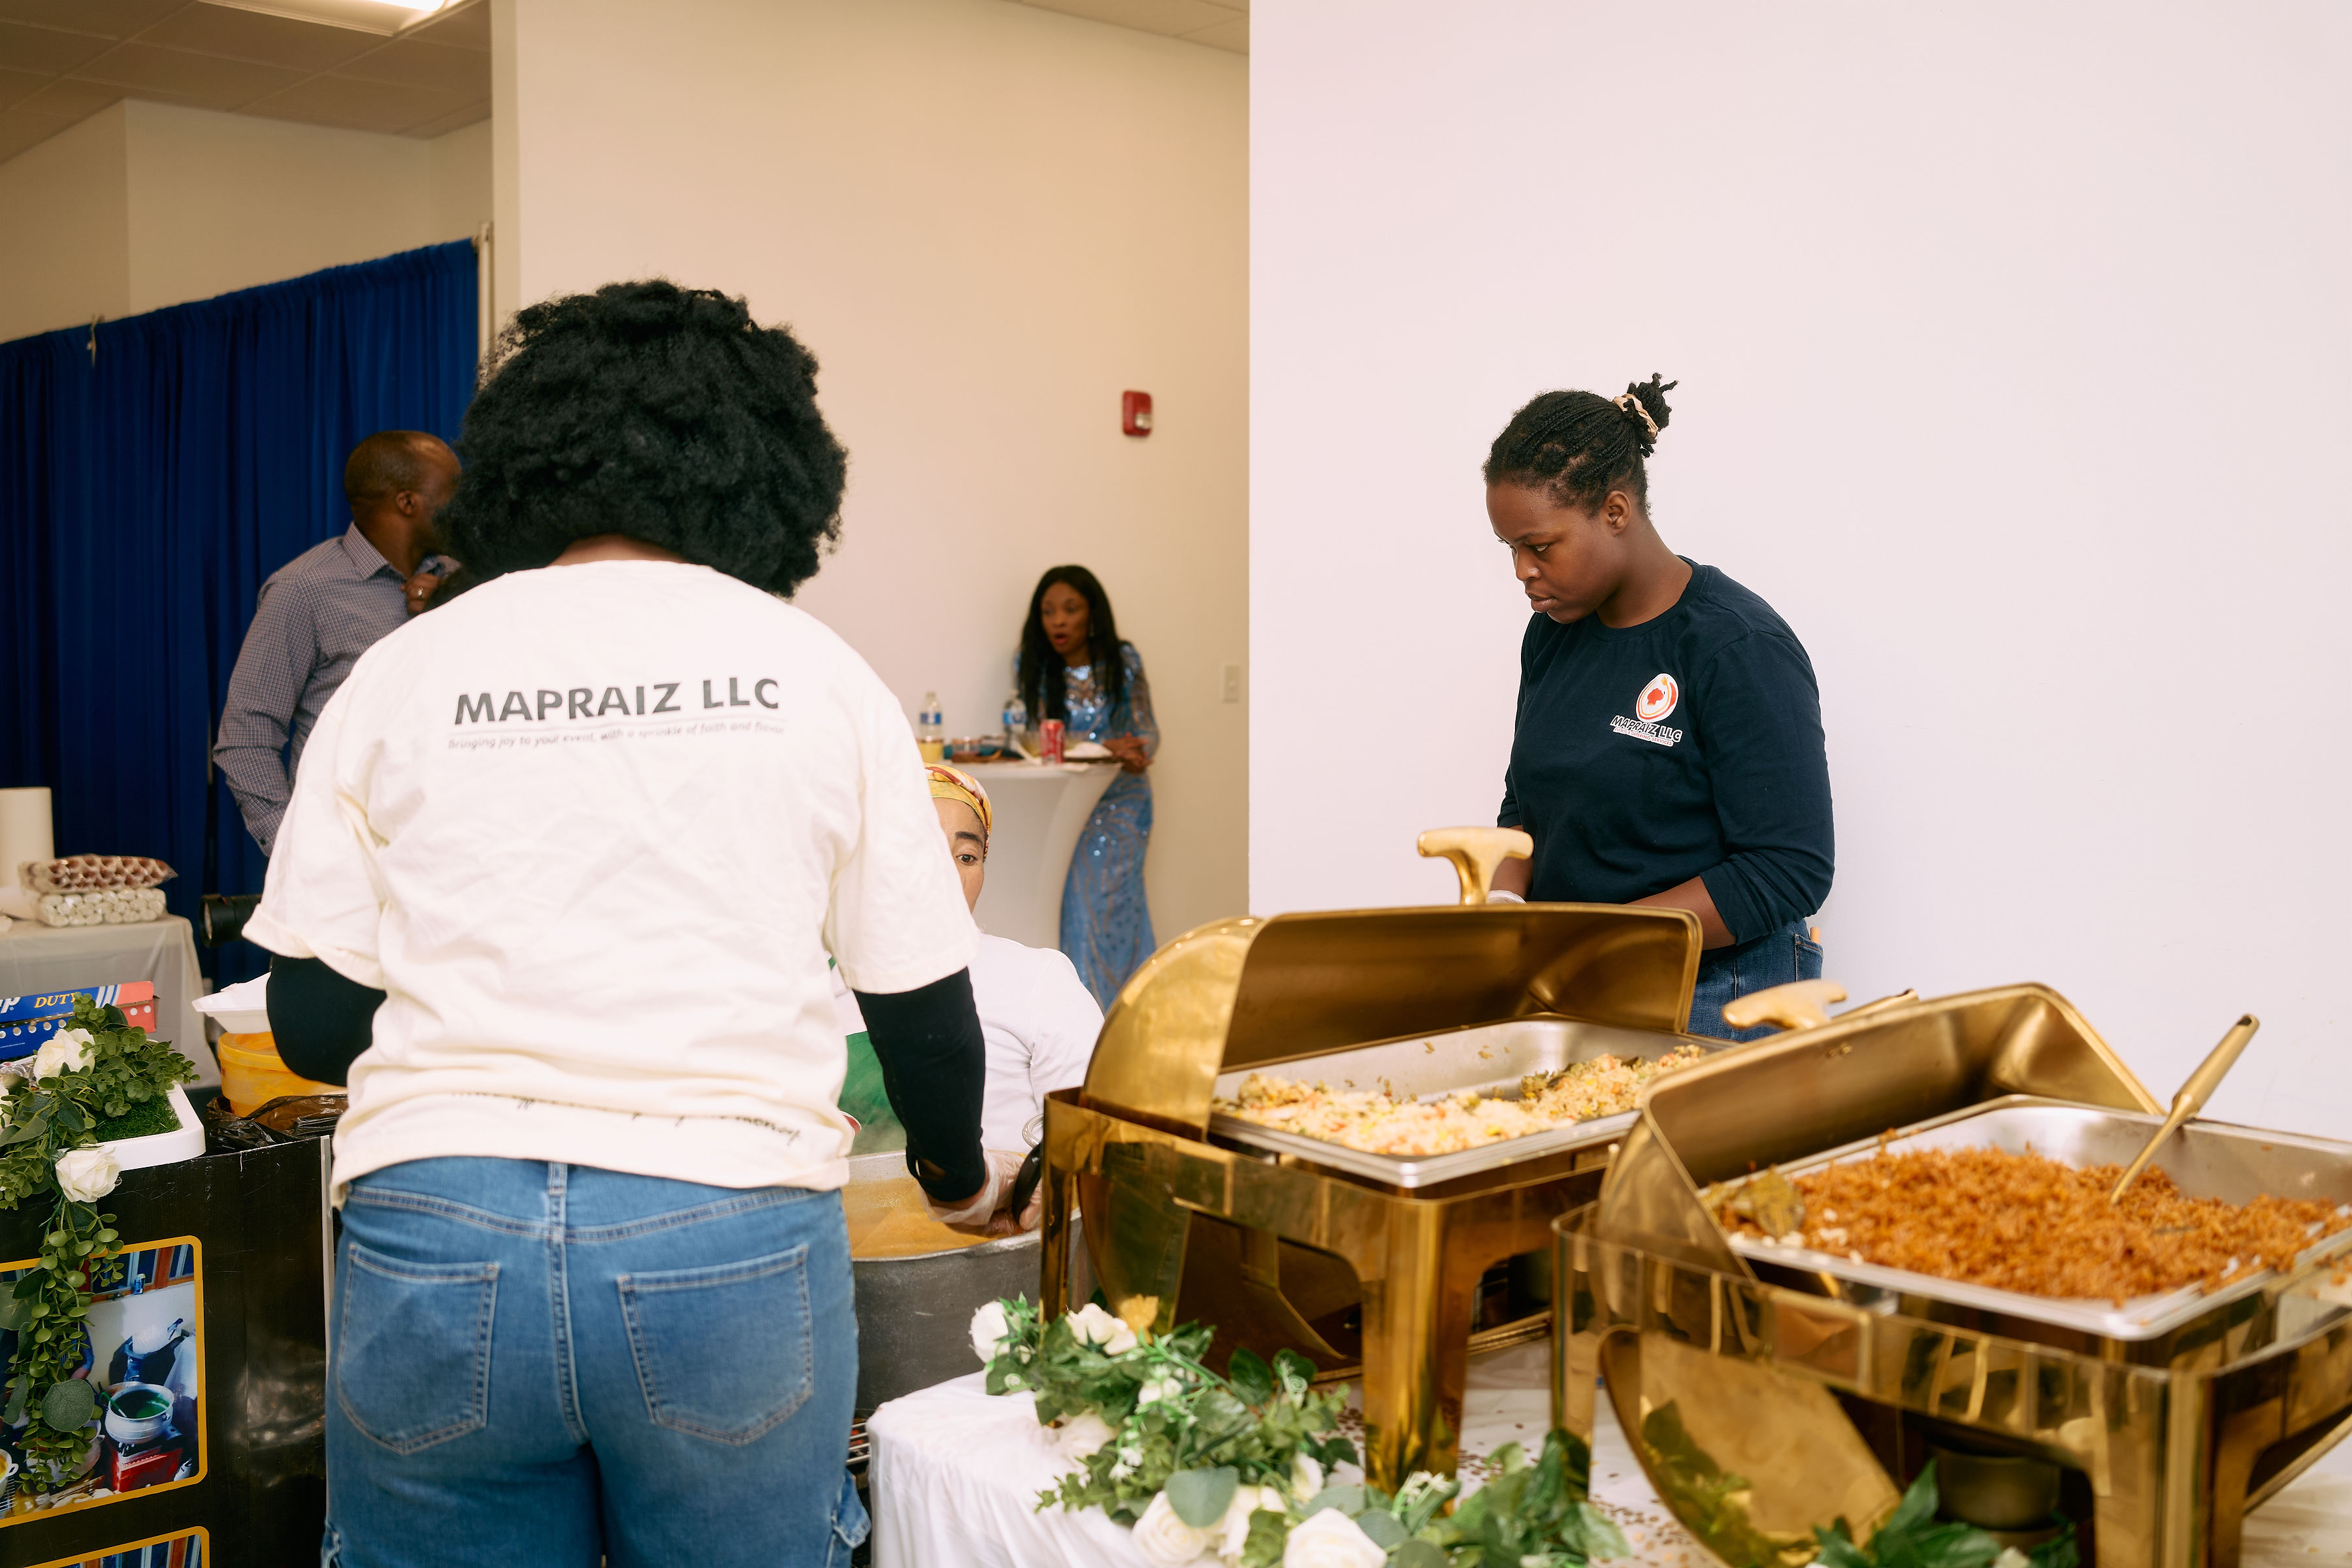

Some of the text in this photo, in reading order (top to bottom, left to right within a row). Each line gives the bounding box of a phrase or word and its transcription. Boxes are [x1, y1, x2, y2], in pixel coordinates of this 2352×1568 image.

[455, 678, 779, 725] MAPRAIZ LLC
[498, 736, 517, 749] joy
[520, 736, 532, 745] to
[600, 728, 623, 741] with
[638, 726, 682, 739] sprinkle
[687, 724, 698, 736] of
[700, 723, 727, 734] faith
[730, 721, 751, 732] and
[1612, 716, 1682, 741] MAPRAIZ LLC
[1631, 732, 1651, 740] CATERING
[1652, 737, 1673, 746] SERVICES
